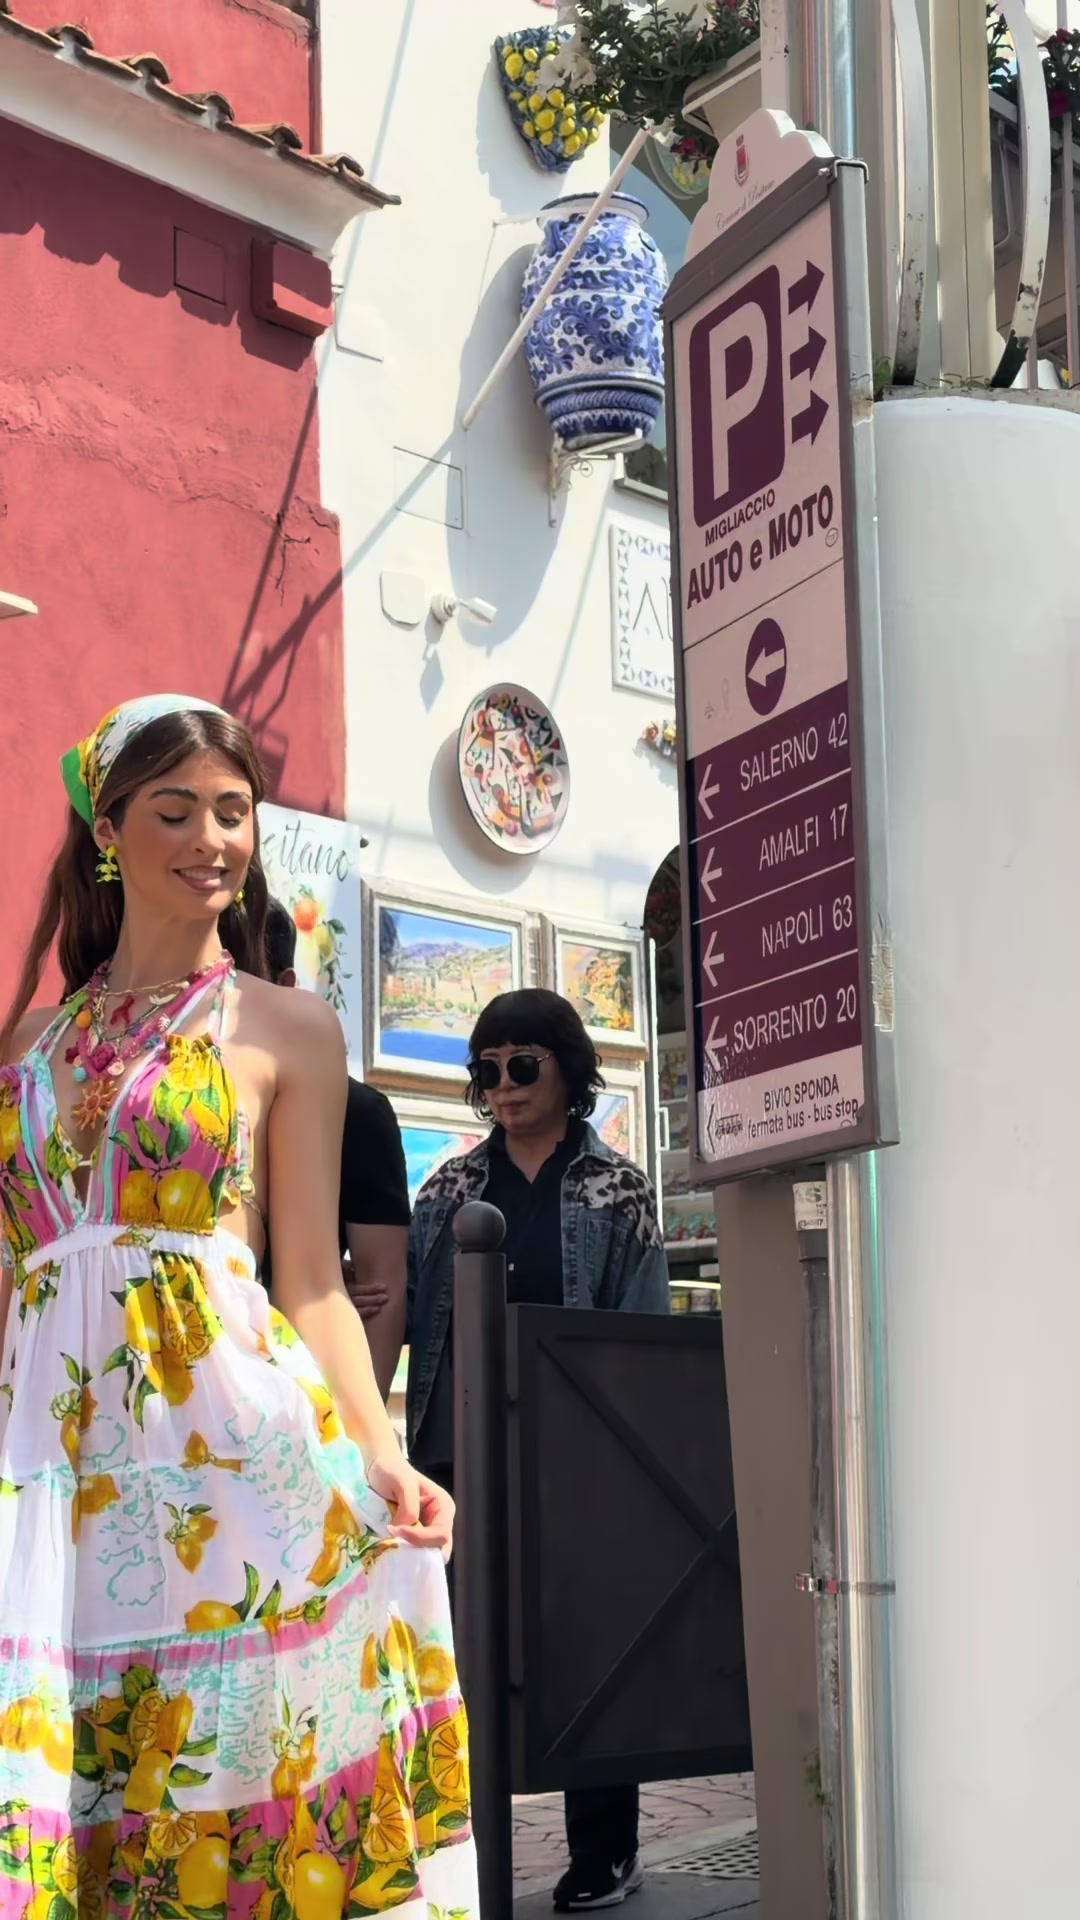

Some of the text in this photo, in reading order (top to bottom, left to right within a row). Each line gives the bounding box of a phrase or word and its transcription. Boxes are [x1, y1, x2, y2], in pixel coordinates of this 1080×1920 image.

[709, 301, 768, 501] P
[686, 484, 833, 610] AUTO e MOTO
[704, 488, 775, 547] MIGLIACCIO
[740, 712, 848, 792] SALERNO 42
[758, 803, 848, 871] AMALFI 17
[761, 894, 853, 957] NAPOLI 63
[733, 983, 857, 1053] SORRENTO 20
[748, 1116, 784, 1140] fermata
[786, 1110, 804, 1129] bus
[813, 1102, 832, 1122] bus
[835, 1097, 859, 1119] stop
[764, 1074, 839, 1112] BIVIO SPONDA
